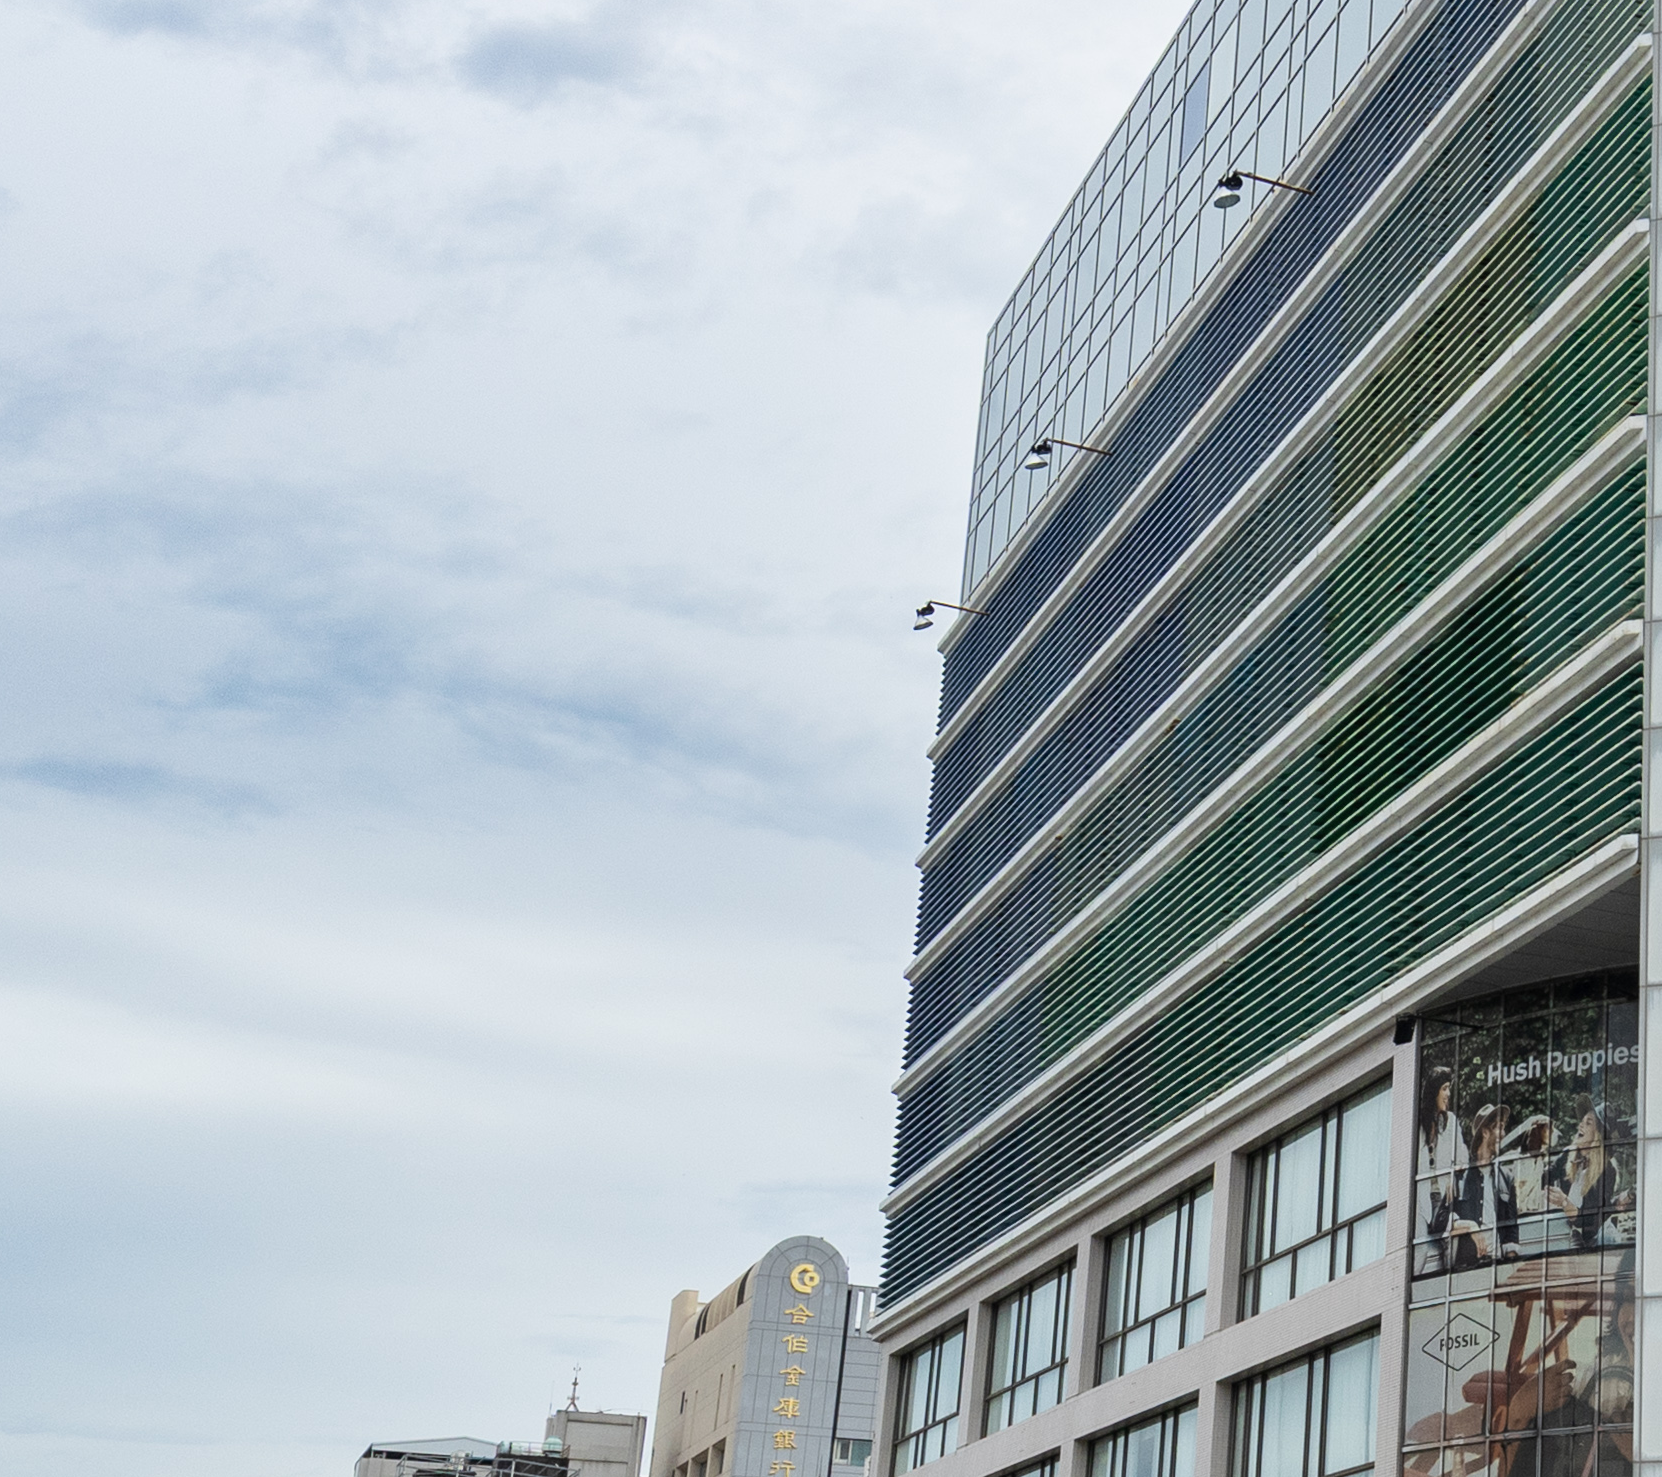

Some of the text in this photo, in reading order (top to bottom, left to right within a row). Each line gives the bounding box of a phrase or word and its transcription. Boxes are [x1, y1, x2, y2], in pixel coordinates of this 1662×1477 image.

[1488, 1043, 1640, 1087] Hush Puppies
[1439, 1332, 1481, 1352] FOSSIL
